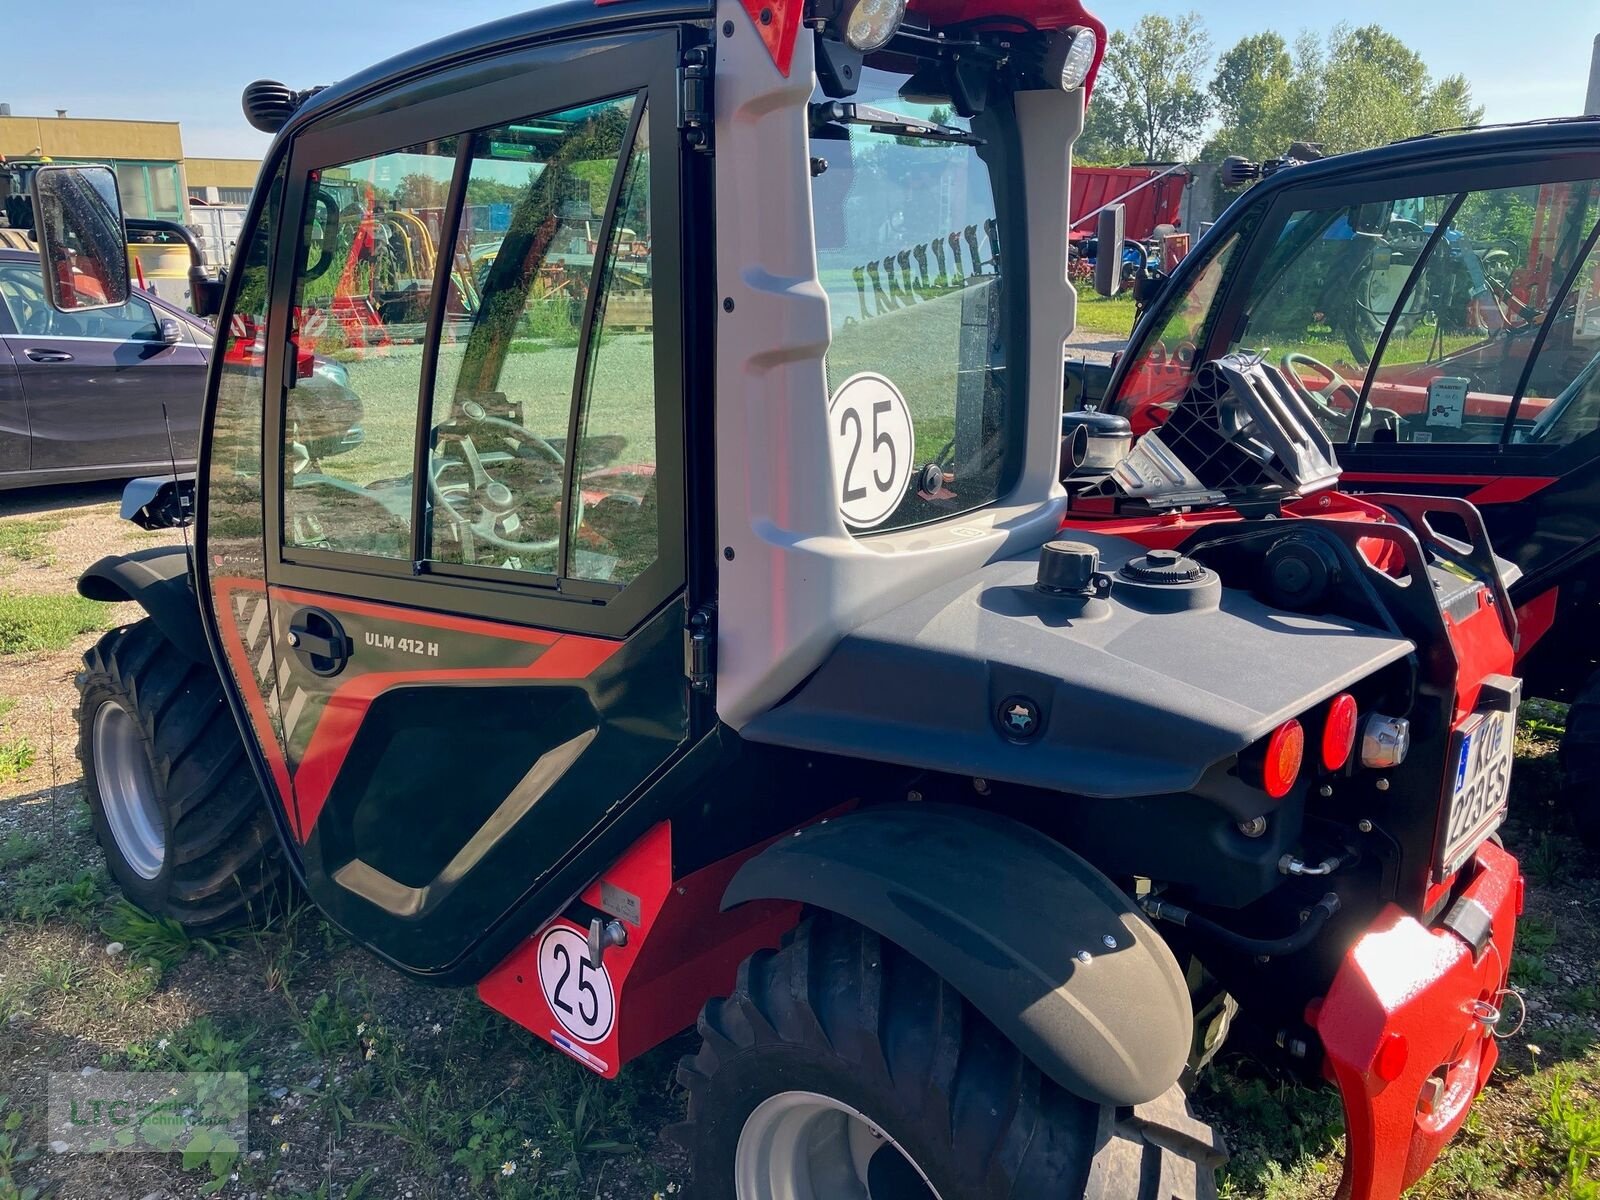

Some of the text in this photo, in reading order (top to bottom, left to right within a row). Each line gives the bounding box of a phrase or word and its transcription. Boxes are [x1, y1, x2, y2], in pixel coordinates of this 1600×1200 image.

[840, 400, 896, 503] 25
[365, 631, 439, 657] ULM 412 H
[1447, 754, 1507, 848] 223ES
[553, 943, 599, 1027] 25
